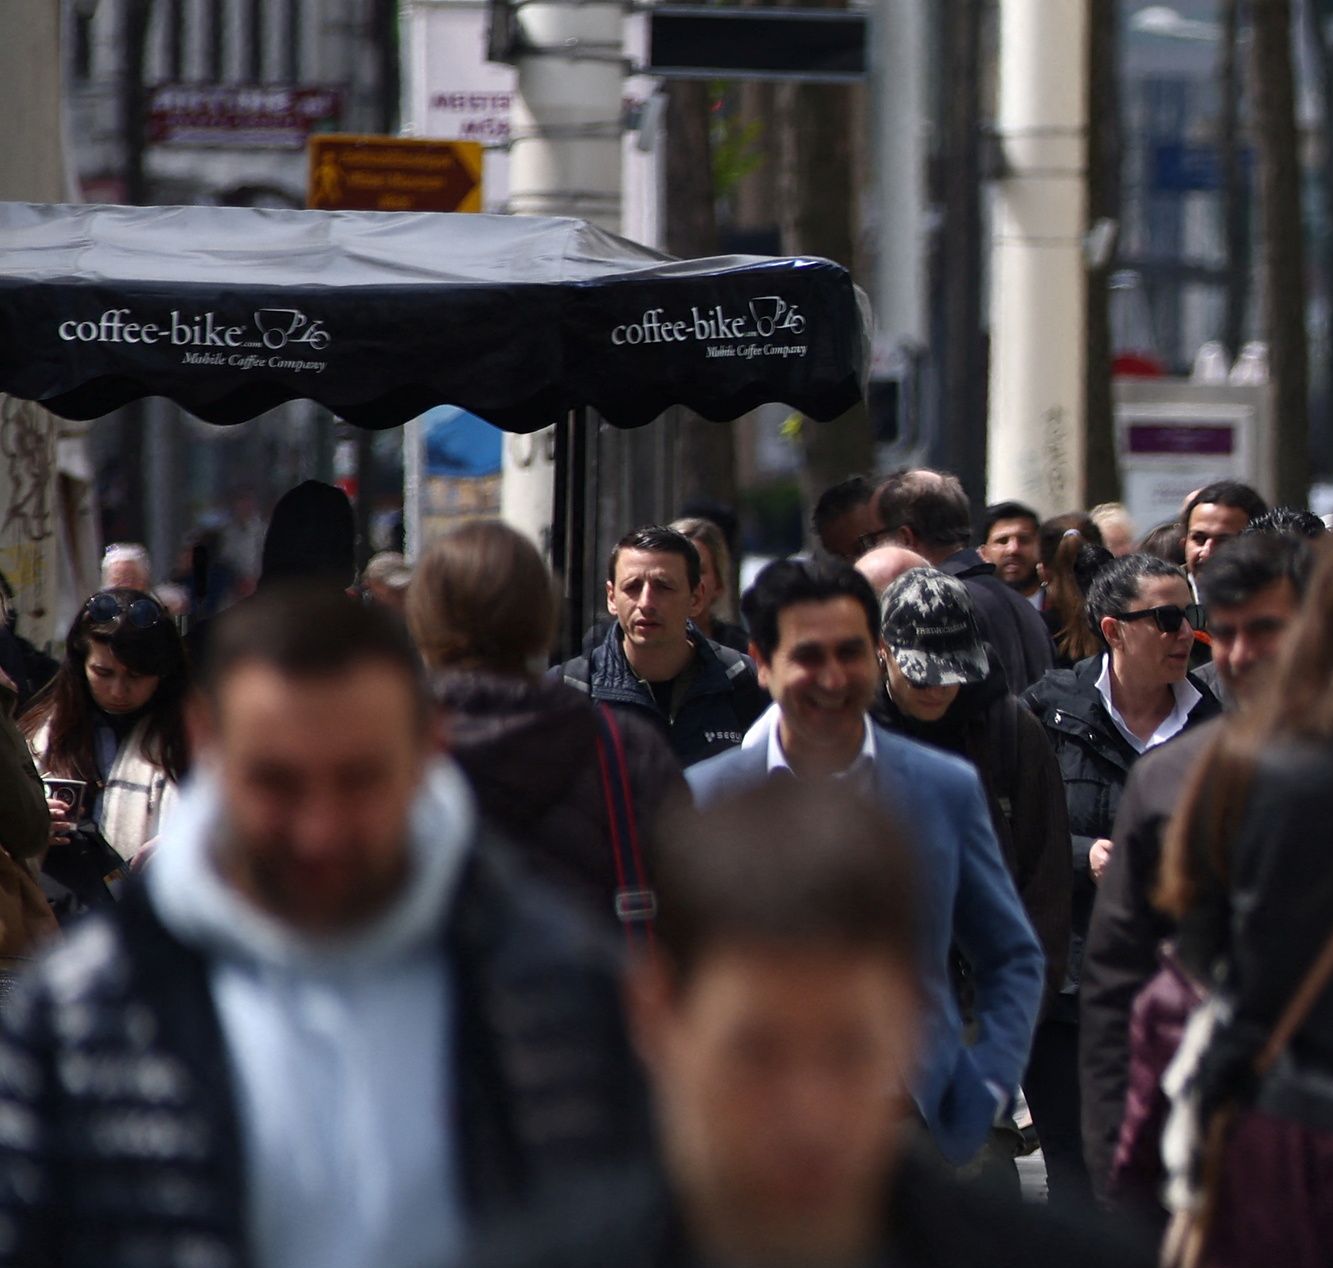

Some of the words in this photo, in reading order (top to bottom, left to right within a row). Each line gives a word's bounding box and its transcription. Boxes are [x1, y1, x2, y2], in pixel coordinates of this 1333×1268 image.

[58, 308, 242, 347] coffee-bike
[611, 305, 745, 346] coffee-bike
[182, 351, 226, 366] Mobile
[228, 353, 267, 370] Coffee
[268, 355, 329, 374] Company
[736, 343, 763, 360] Coffee
[763, 343, 808, 358] Company
